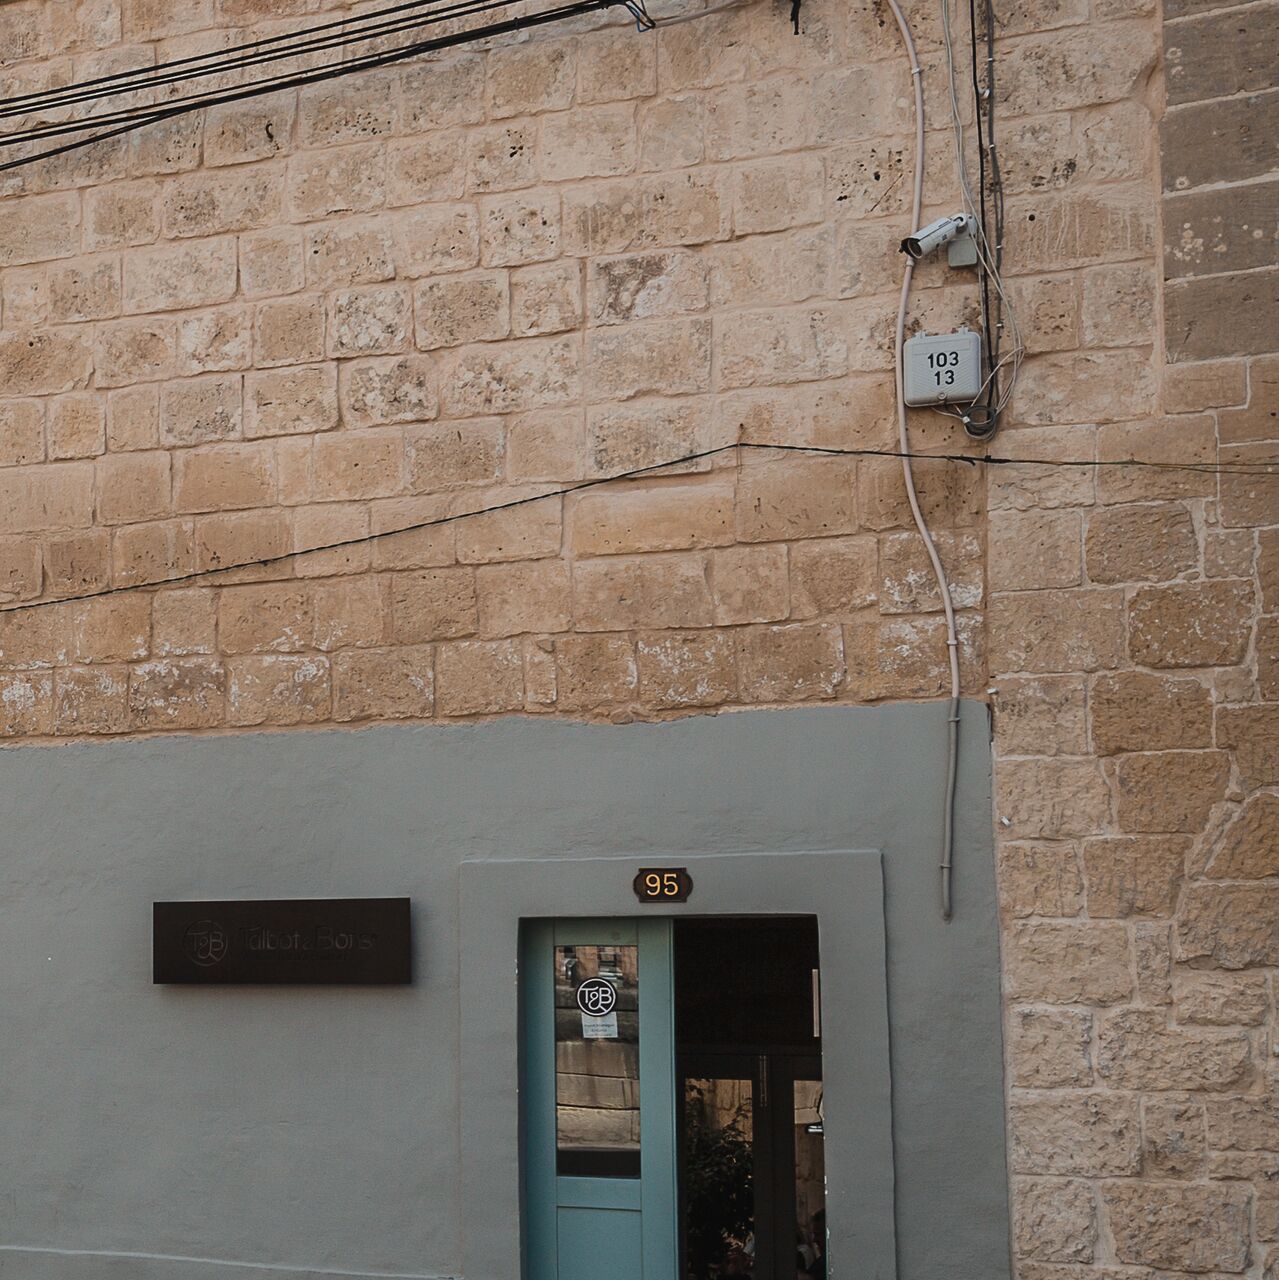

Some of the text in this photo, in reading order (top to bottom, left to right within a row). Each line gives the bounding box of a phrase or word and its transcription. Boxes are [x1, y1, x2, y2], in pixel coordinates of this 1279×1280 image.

[927, 351, 959, 369] 103
[934, 370, 955, 386] 13
[645, 873, 679, 896] 95
